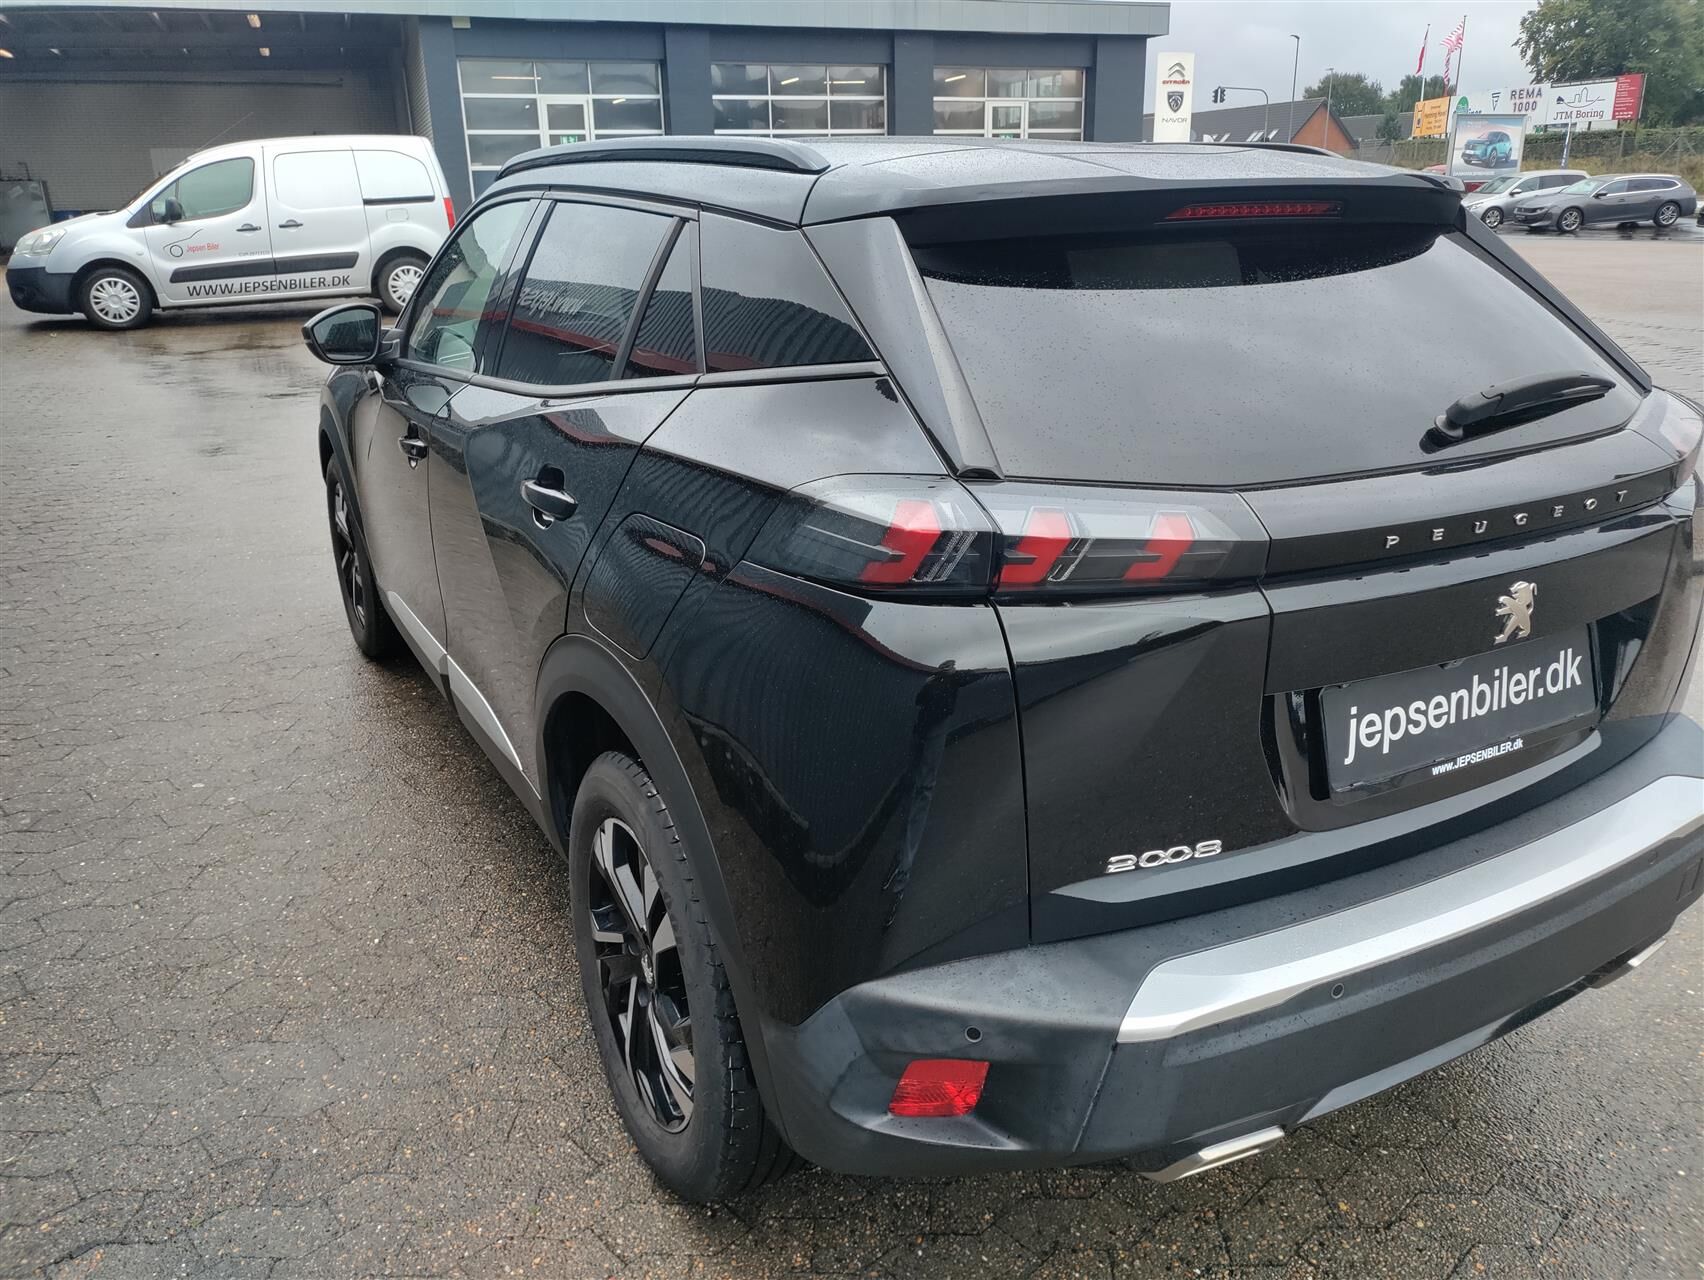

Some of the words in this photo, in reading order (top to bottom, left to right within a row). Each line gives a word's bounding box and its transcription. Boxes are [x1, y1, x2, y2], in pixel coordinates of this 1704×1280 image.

[1510, 87, 1543, 100] REMA
[1512, 101, 1537, 113] 1000
[1553, 110, 1574, 121] JTM
[1576, 109, 1604, 119] Boring
[186, 244, 206, 253] Jepsen
[207, 242, 220, 251] Biler
[187, 275, 350, 297] WWW.JEPSENBILER.DK
[1385, 490, 1628, 549] PEUGEOT
[1344, 648, 1582, 765] jepsenbiler.dk
[1431, 738, 1524, 776] www.JEPSENBILER.dk
[1105, 839, 1223, 874] 2008
